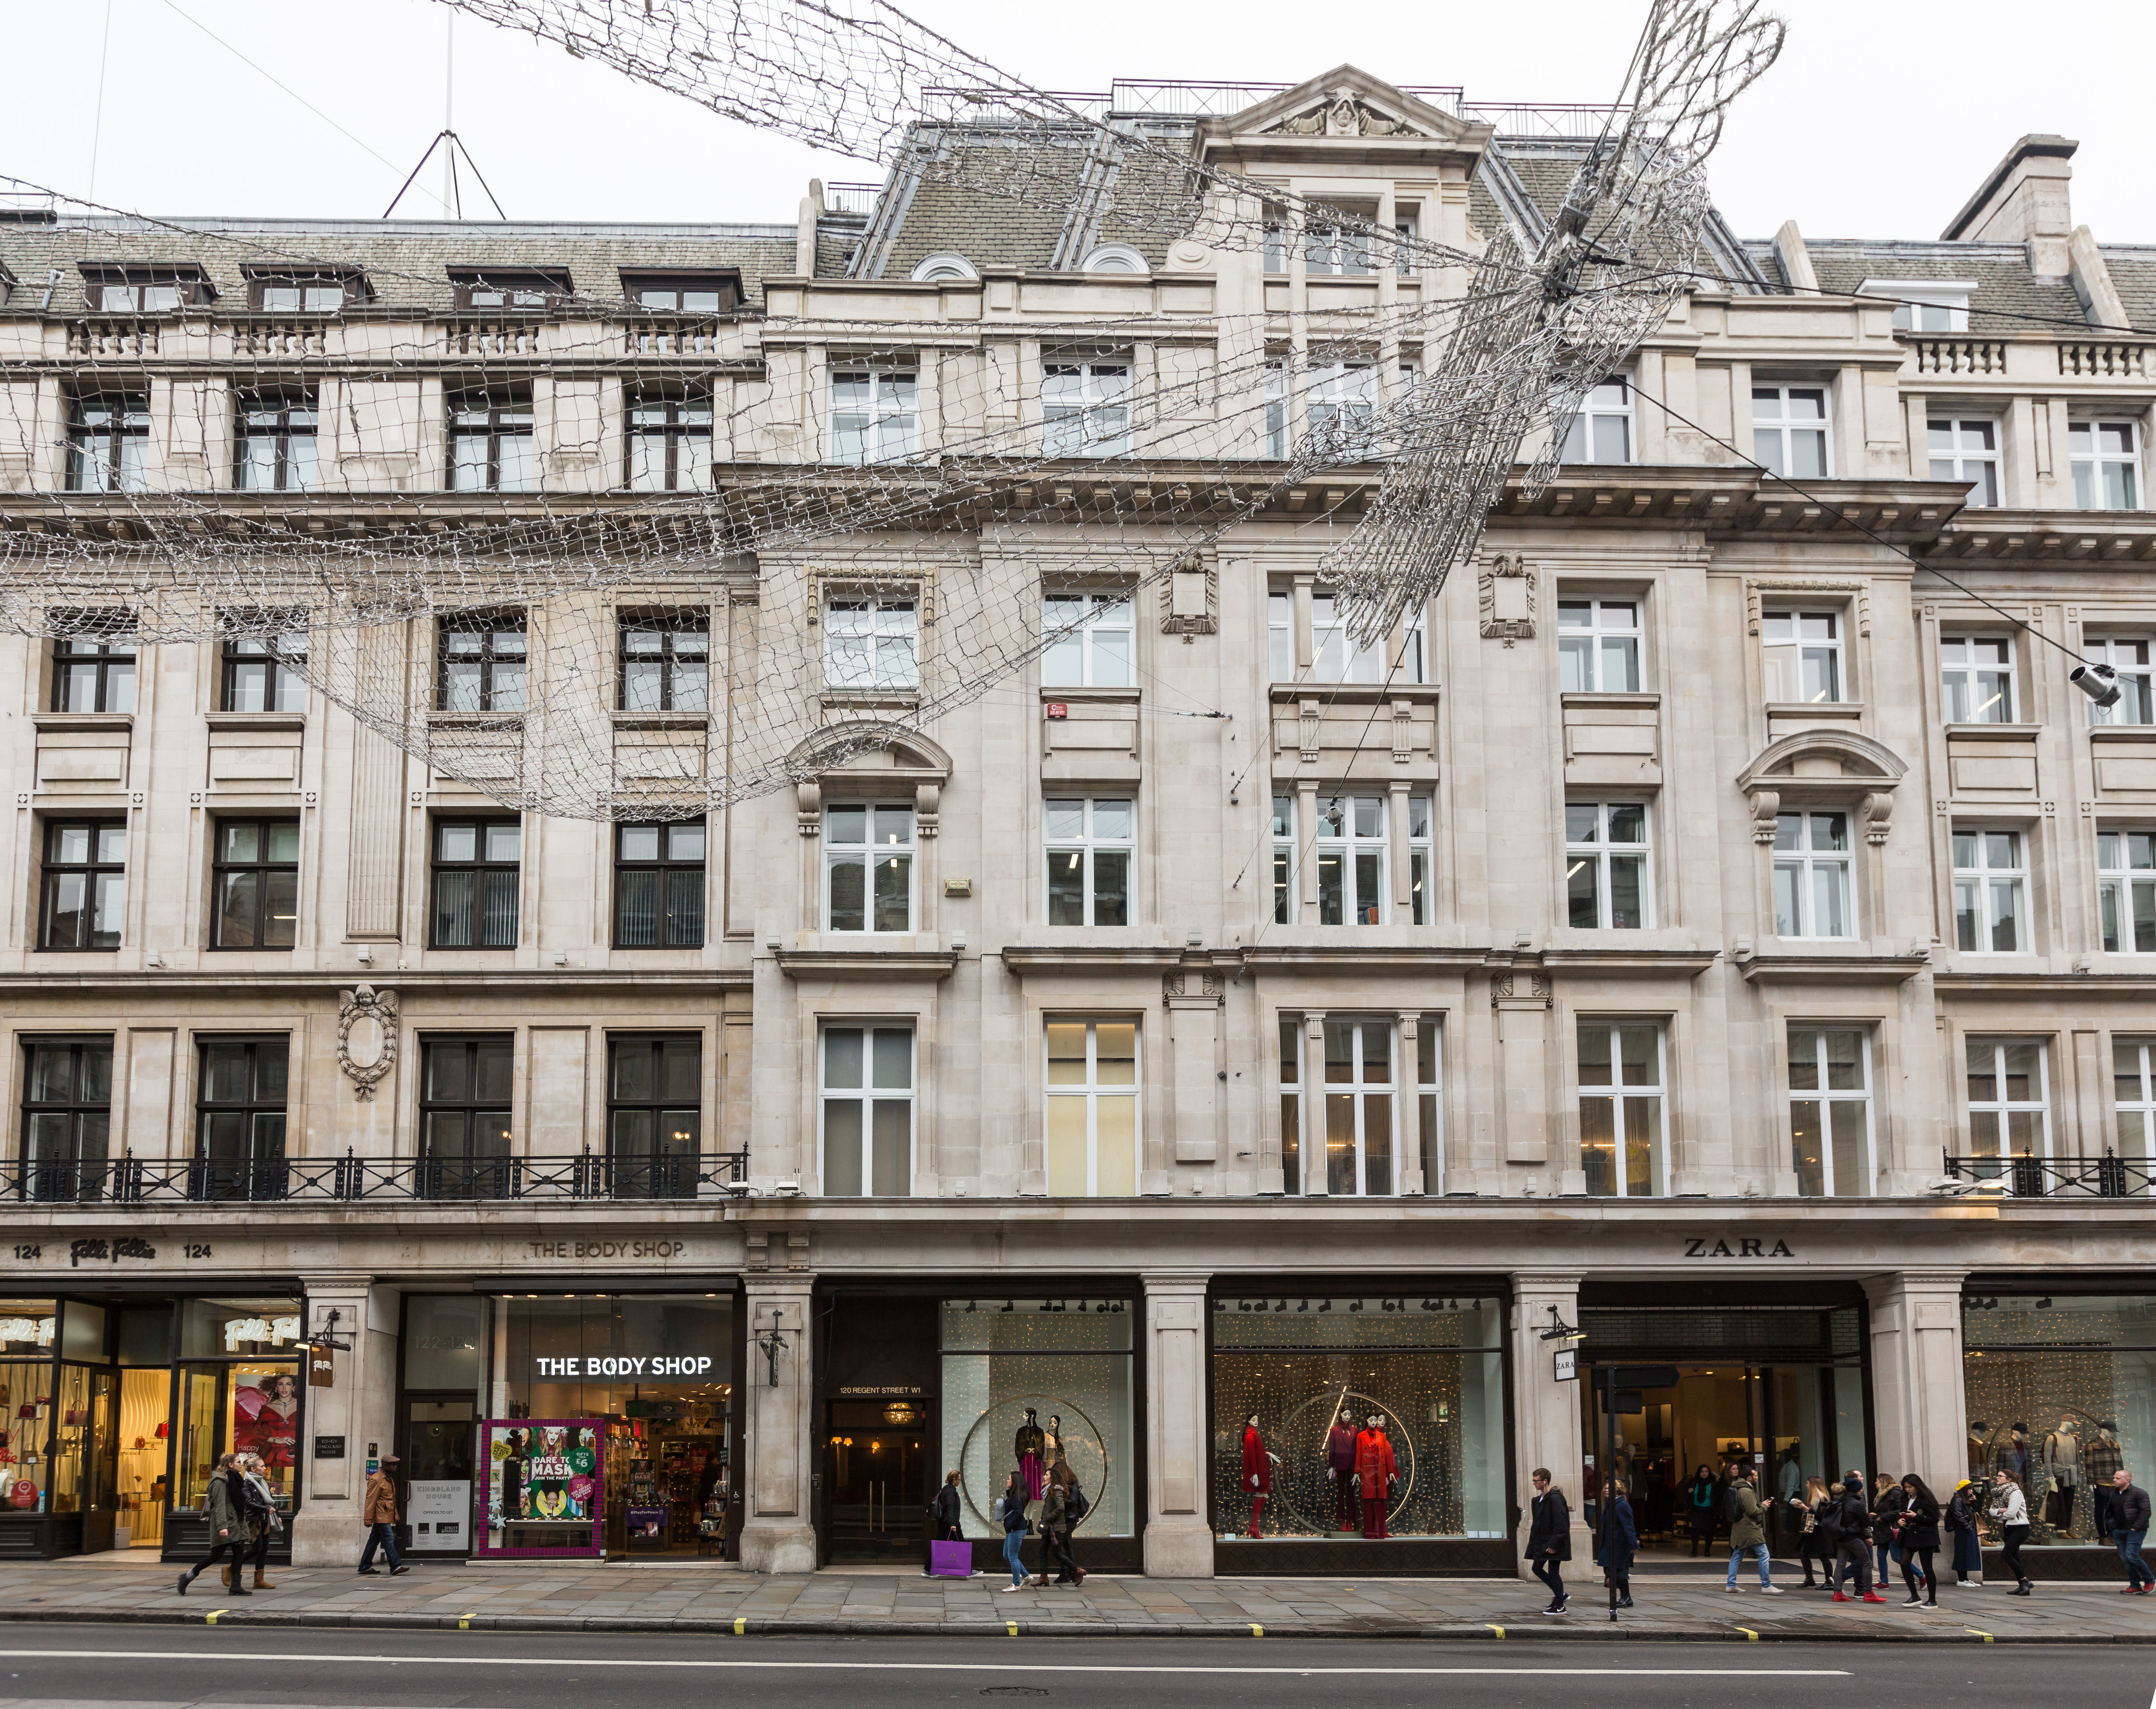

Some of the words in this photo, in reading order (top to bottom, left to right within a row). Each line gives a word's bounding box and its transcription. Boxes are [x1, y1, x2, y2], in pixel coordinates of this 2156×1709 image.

[14, 1245, 41, 1259] 124
[71, 1239, 109, 1267] Folli
[112, 1238, 155, 1263] Follie
[184, 1244, 211, 1259] 124
[531, 1242, 567, 1257] THE
[575, 1242, 628, 1257] BODY
[633, 1241, 683, 1257] SHOP
[1685, 1239, 1795, 1257] ZARA
[225, 1318, 271, 1351] Folli
[414, 1336, 475, 1349] 122-124
[537, 1358, 579, 1375] THE
[588, 1357, 646, 1375] BODY
[652, 1357, 711, 1375] SHOP
[1556, 1361, 1574, 1370] ZARA
[238, 1444, 259, 1453] Happy
[495, 1446, 509, 1454] PEACE
[576, 1458, 588, 1467] £6
[532, 1464, 574, 1475] MASK
[573, 1486, 592, 1497] CALENDARS
[579, 1483, 591, 1491] ADVENT
